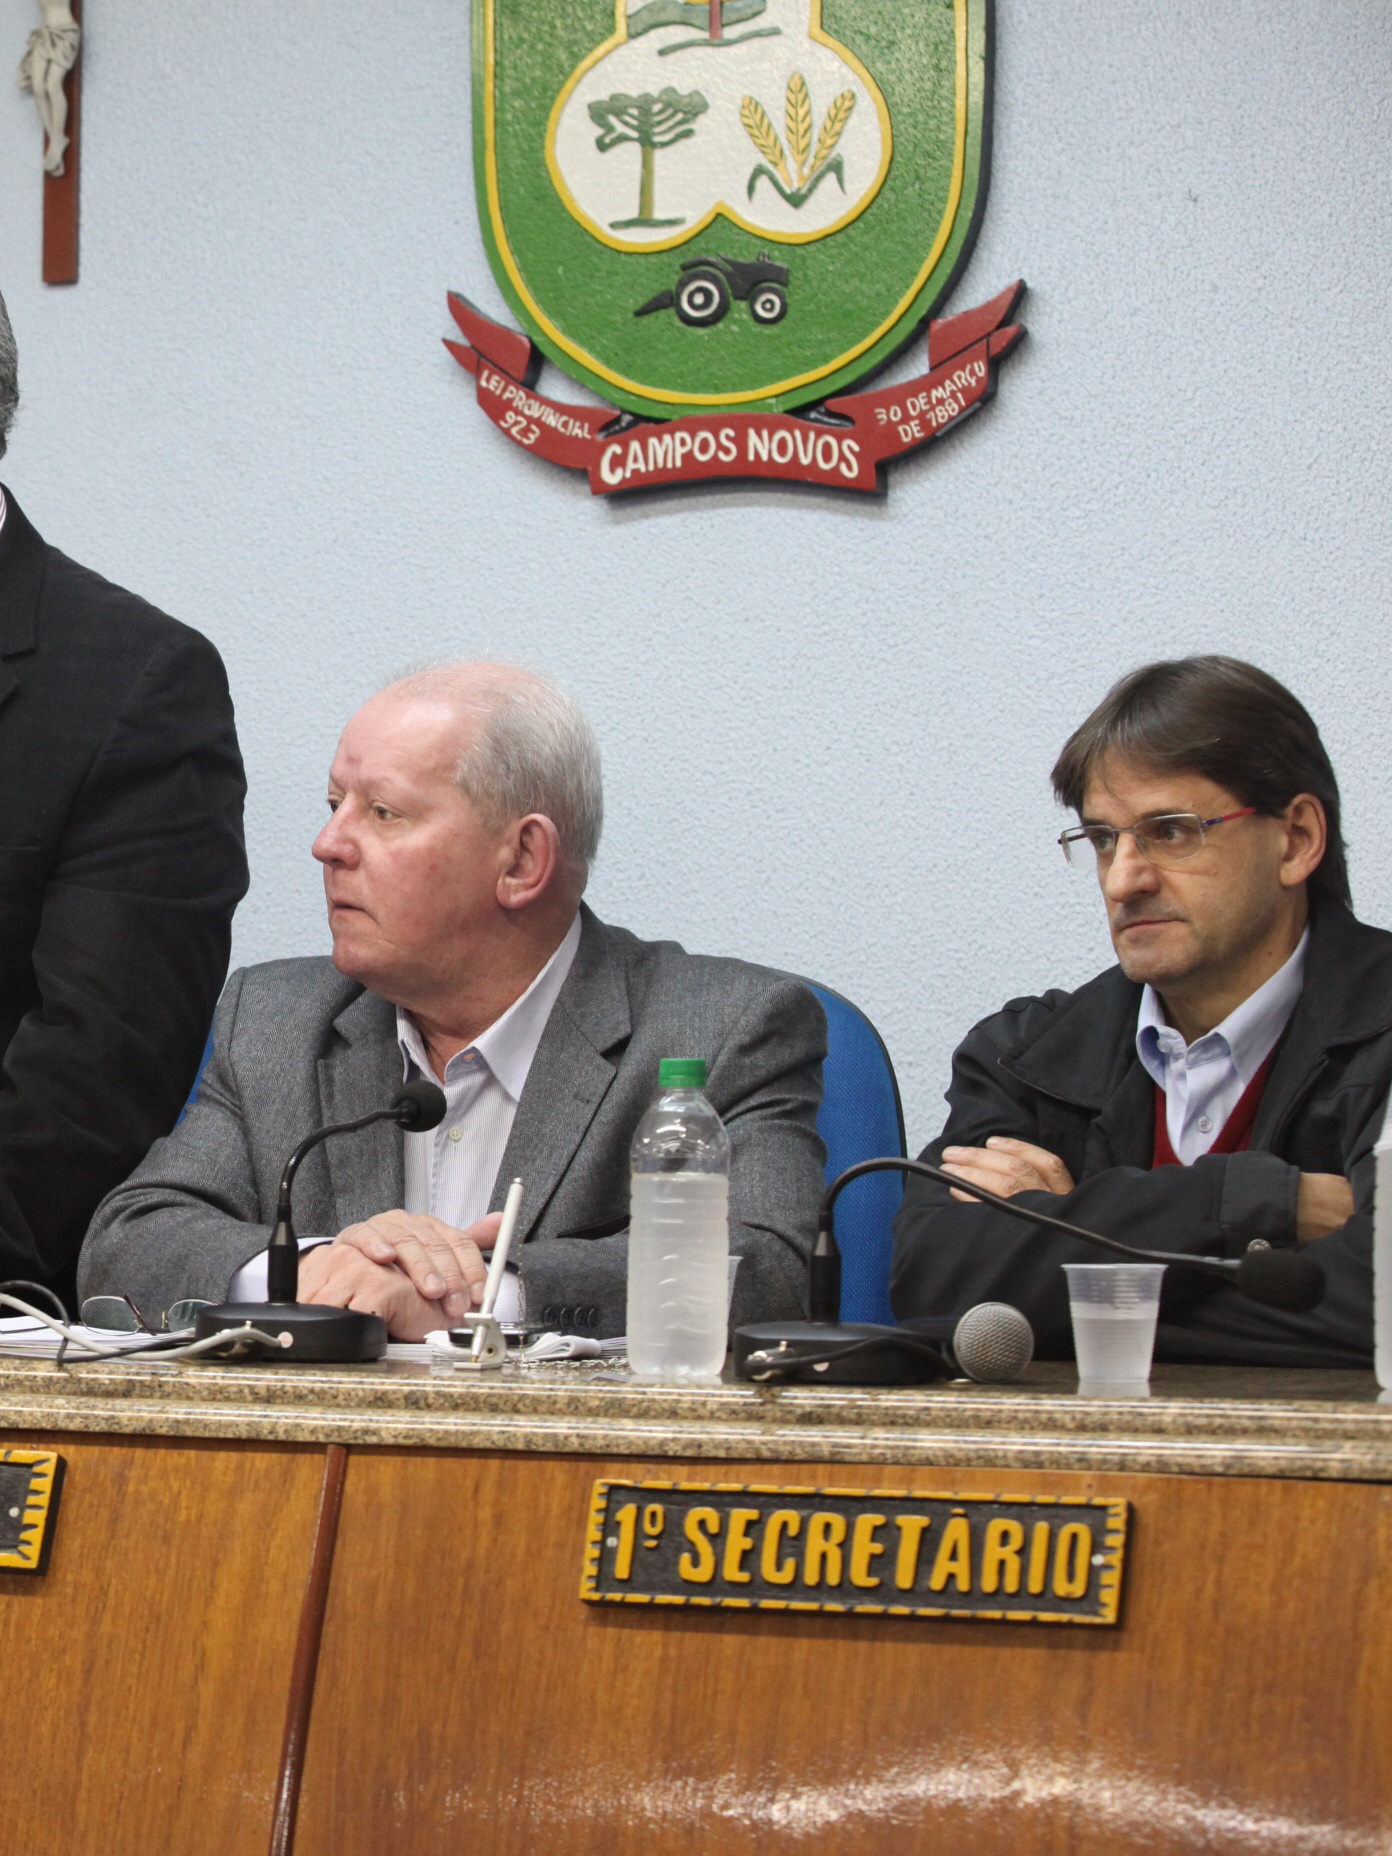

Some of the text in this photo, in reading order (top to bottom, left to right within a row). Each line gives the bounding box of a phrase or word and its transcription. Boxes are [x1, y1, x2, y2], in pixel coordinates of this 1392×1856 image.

[479, 369, 591, 439] LEI PROVINCIAL
[499, 410, 540, 445] 923
[874, 405, 902, 425] 30
[906, 392, 930, 416] DE
[897, 392, 966, 442] DE 1881
[600, 427, 860, 485] CAMPOS NOVOS
[678, 1507, 1093, 1599] SECRETÁRIO
